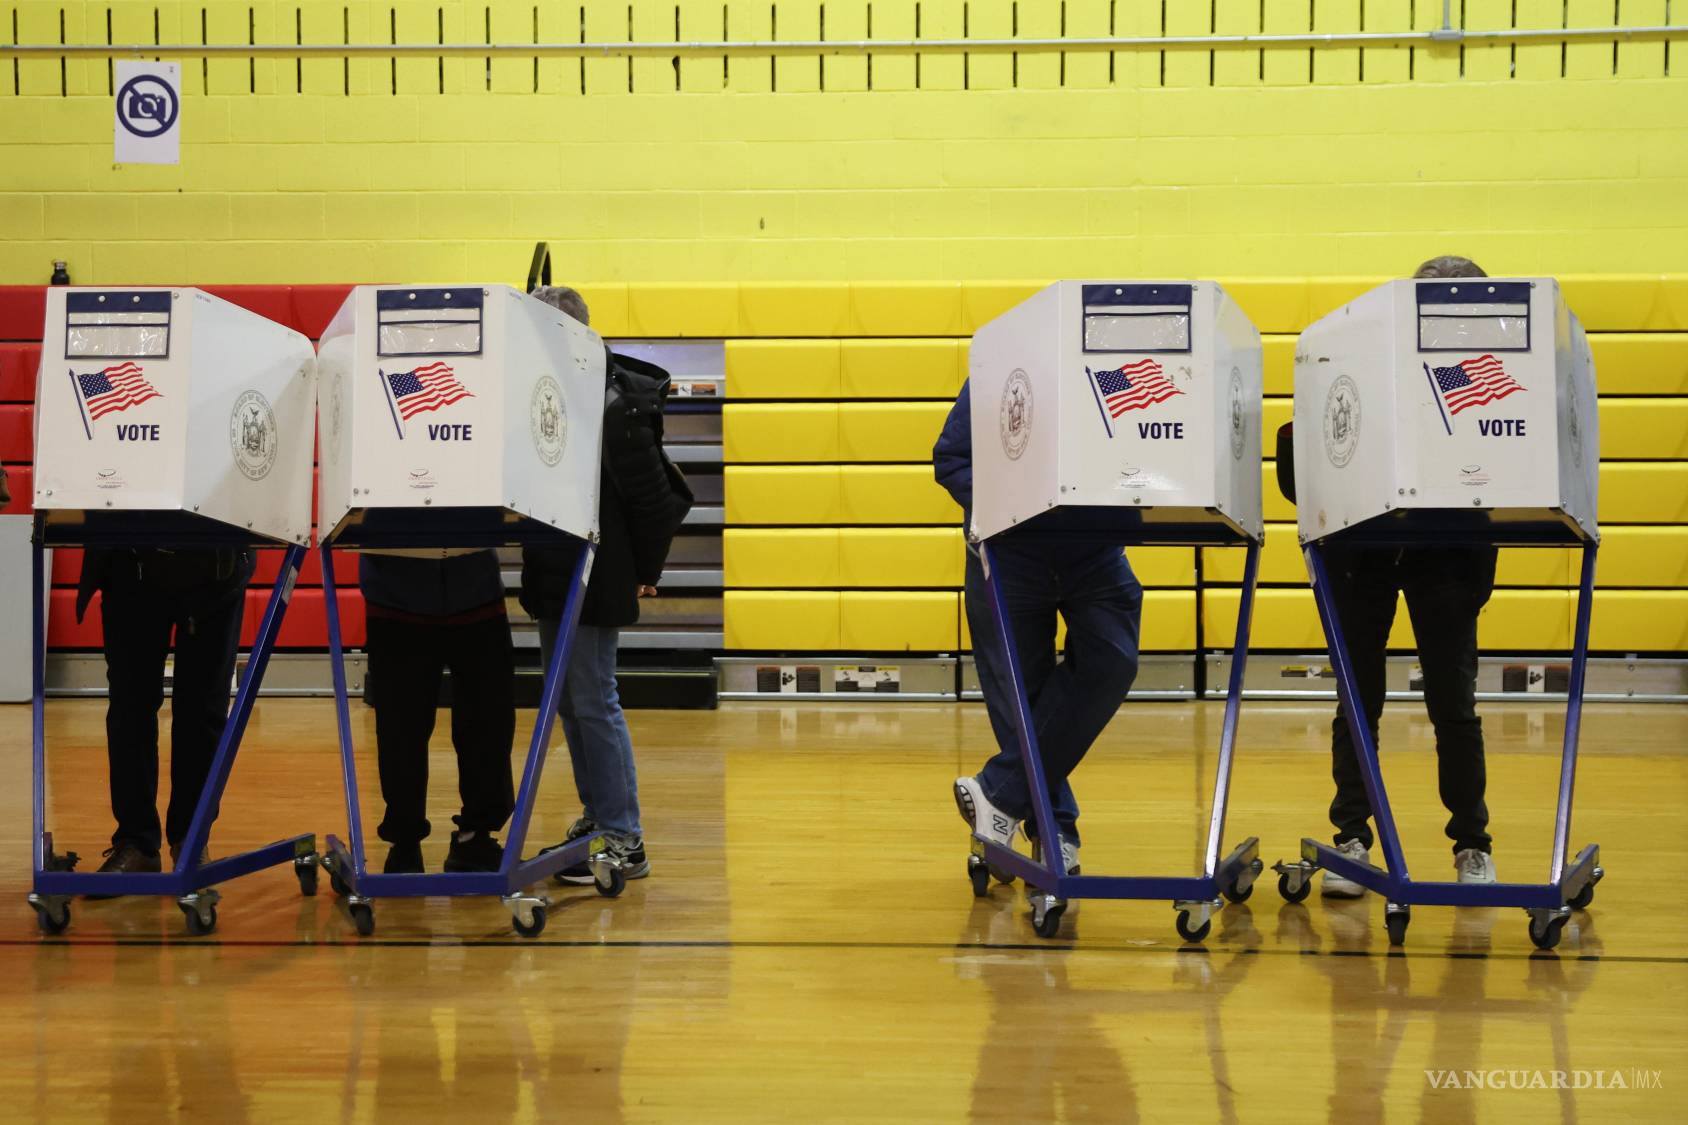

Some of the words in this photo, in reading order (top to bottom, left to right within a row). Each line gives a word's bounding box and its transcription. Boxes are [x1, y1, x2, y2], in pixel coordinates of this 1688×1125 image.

[117, 424, 160, 442] VOTE
[428, 423, 472, 442] VOTE
[1137, 422, 1184, 440] VOTE
[1478, 418, 1526, 437] VOTE
[993, 814, 1008, 835] N
